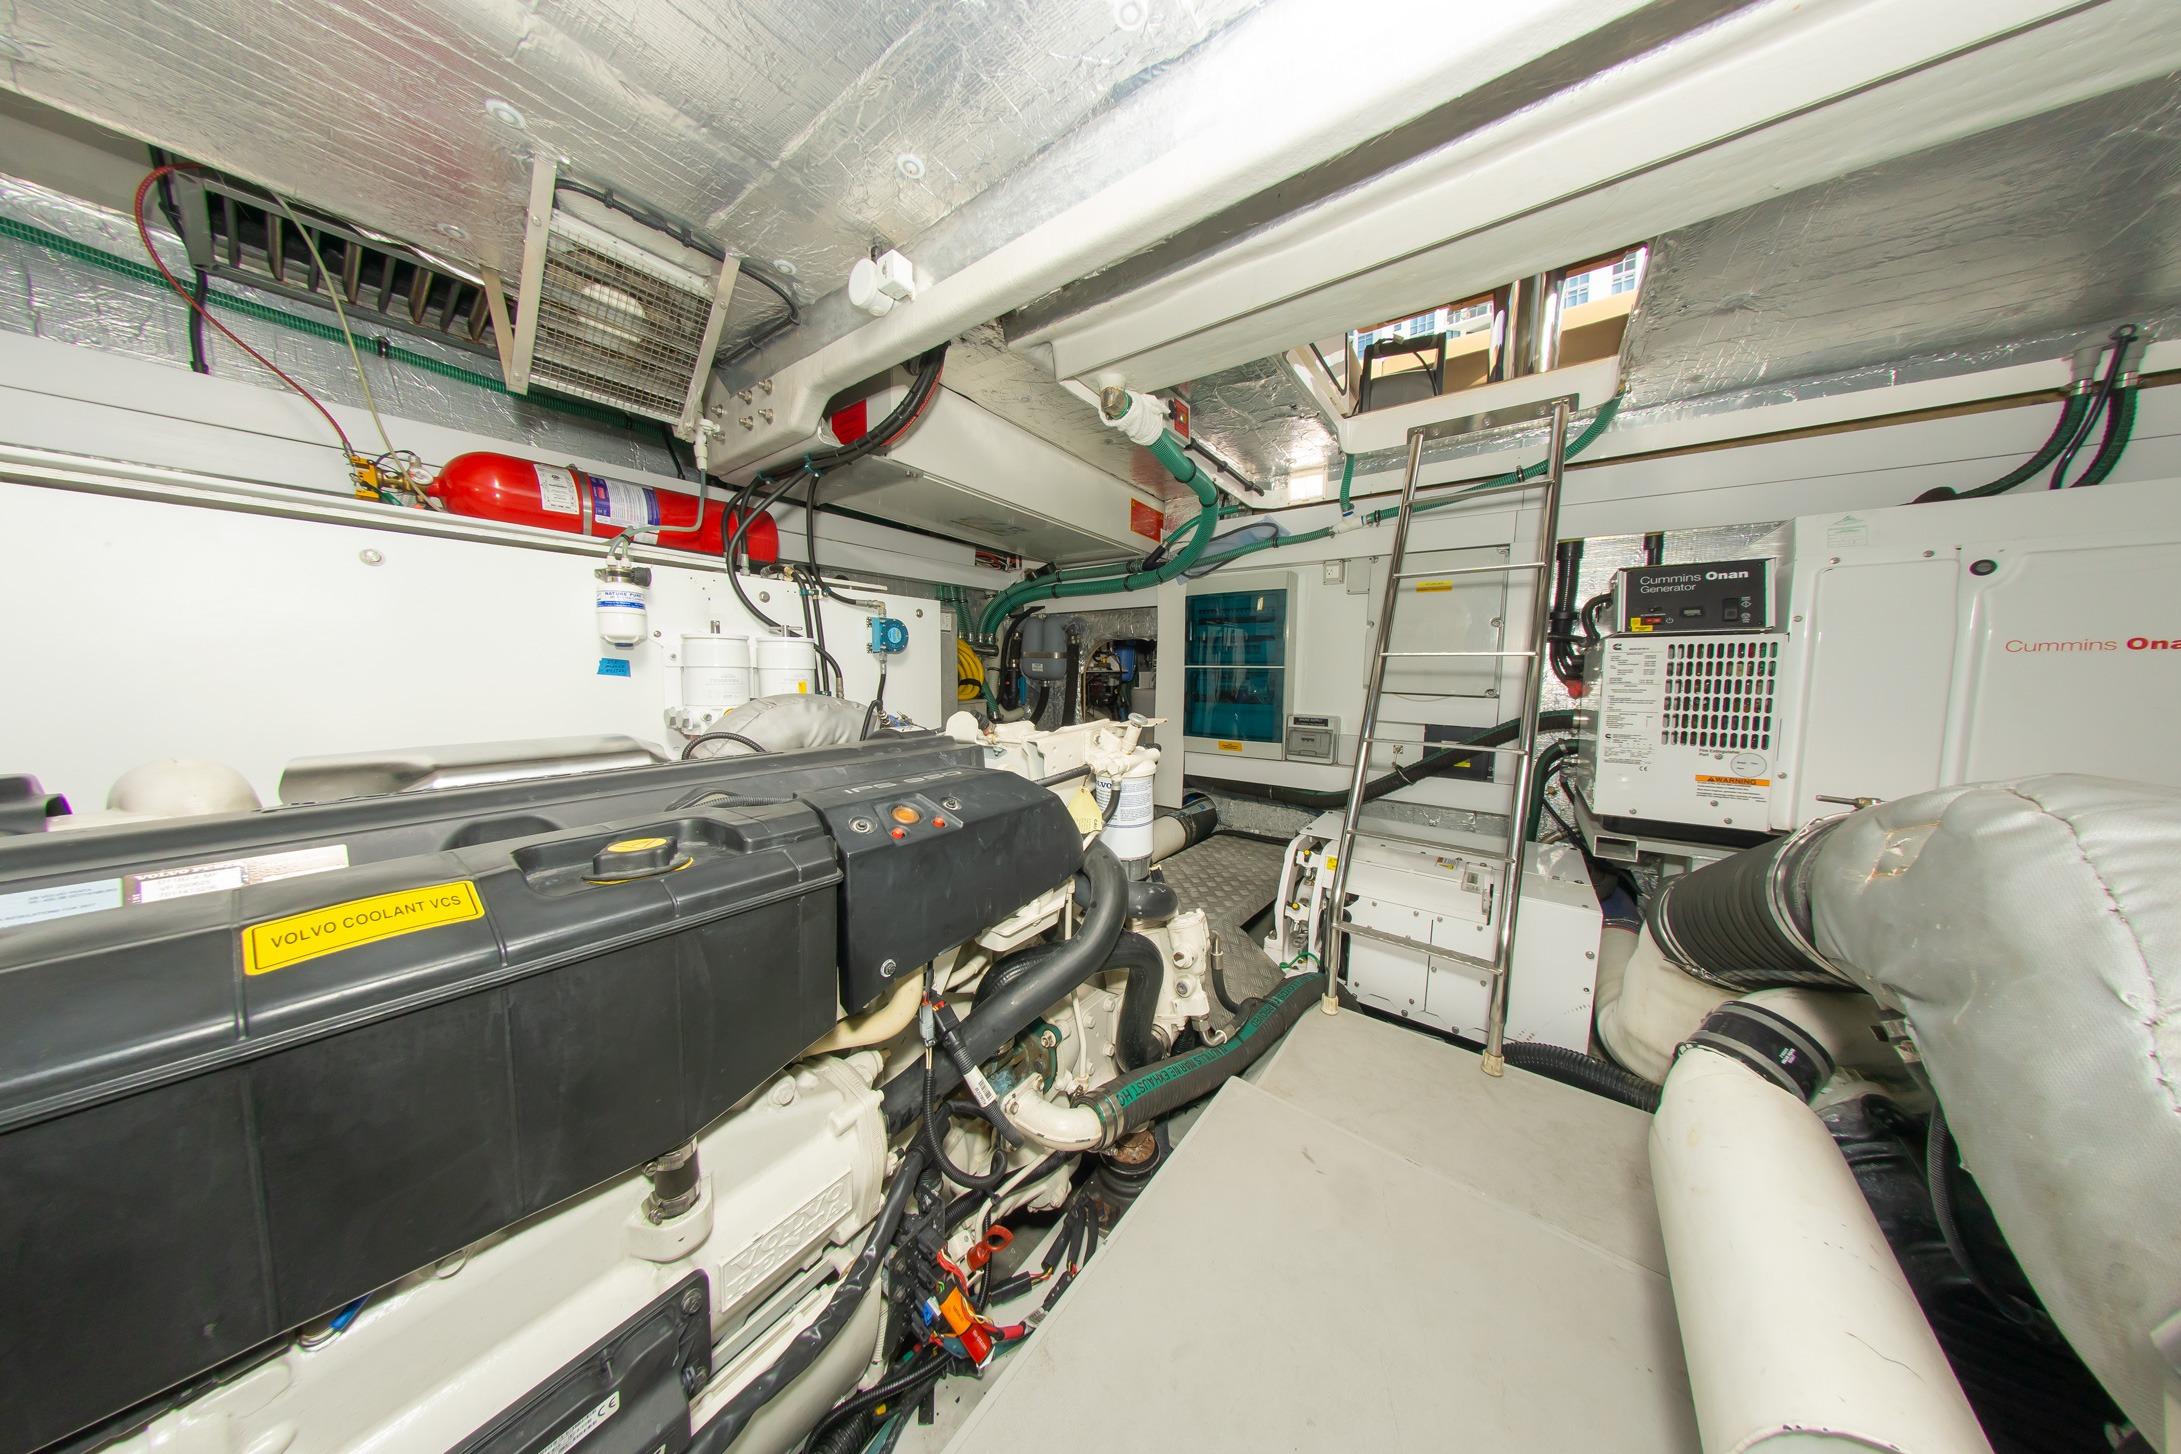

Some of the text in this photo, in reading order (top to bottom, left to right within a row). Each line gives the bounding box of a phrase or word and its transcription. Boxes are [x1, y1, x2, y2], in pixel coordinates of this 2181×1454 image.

[1640, 571, 1749, 585] Cummins Onan
[1640, 584, 1697, 594] Generator
[2005, 638, 2118, 653] Cummins
[1714, 776, 1757, 786] WARNING
[271, 895, 462, 948] VOLVO COOLANT VCS
[1132, 1070, 1171, 1096] EXHAUST
